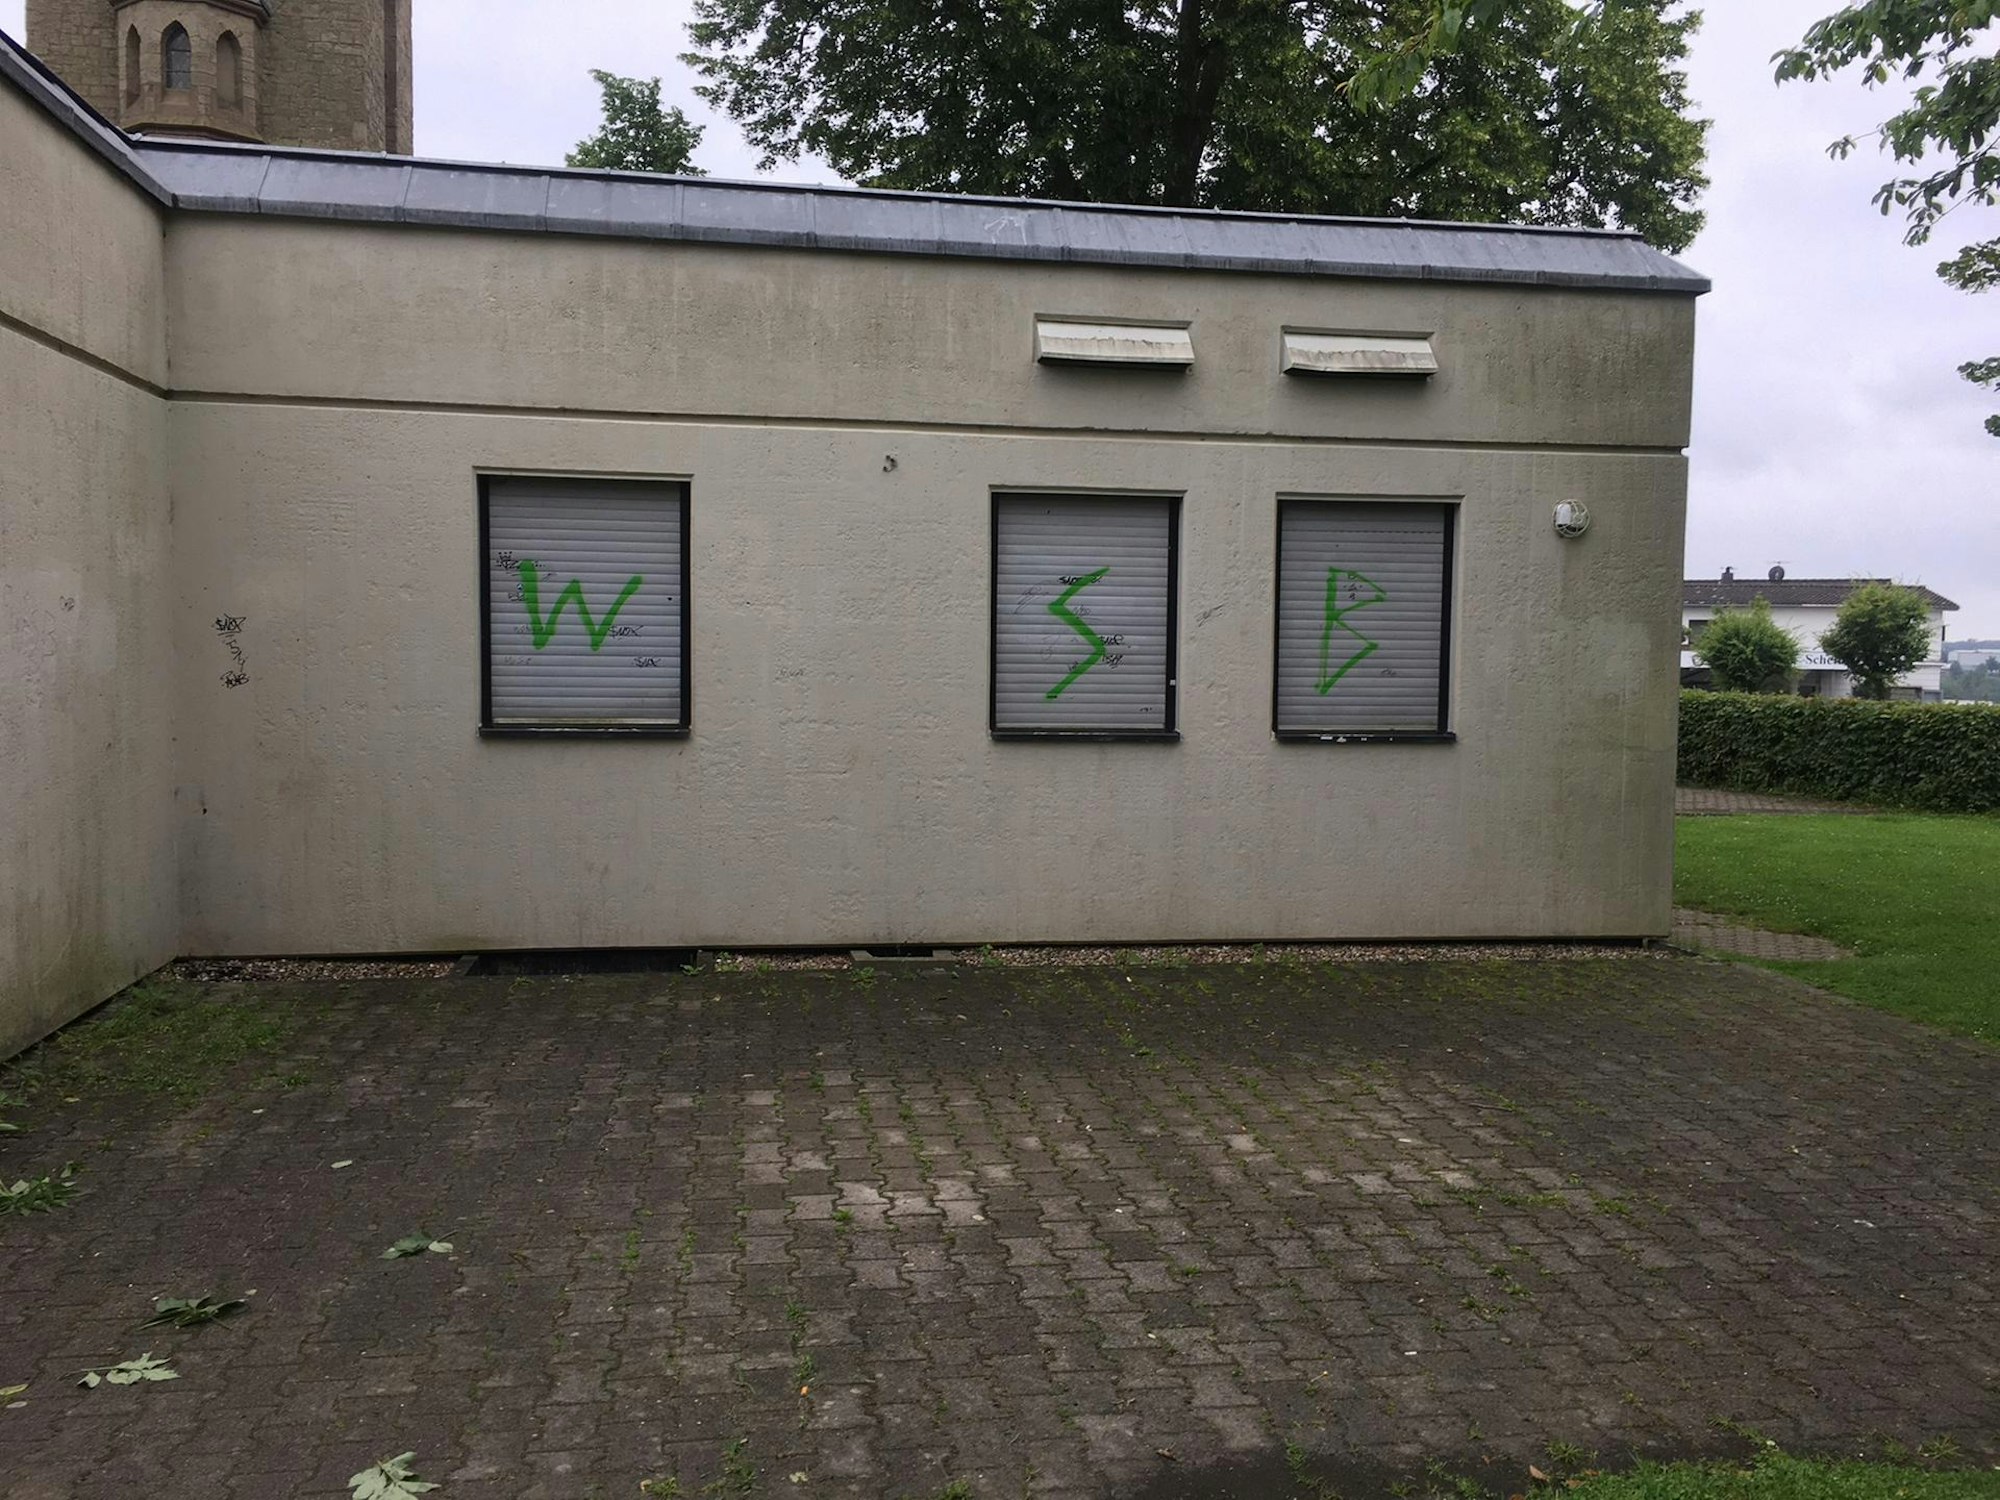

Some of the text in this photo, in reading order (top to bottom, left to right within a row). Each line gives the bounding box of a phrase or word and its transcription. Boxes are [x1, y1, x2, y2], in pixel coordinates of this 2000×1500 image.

[519, 558, 1387, 700] W S B
